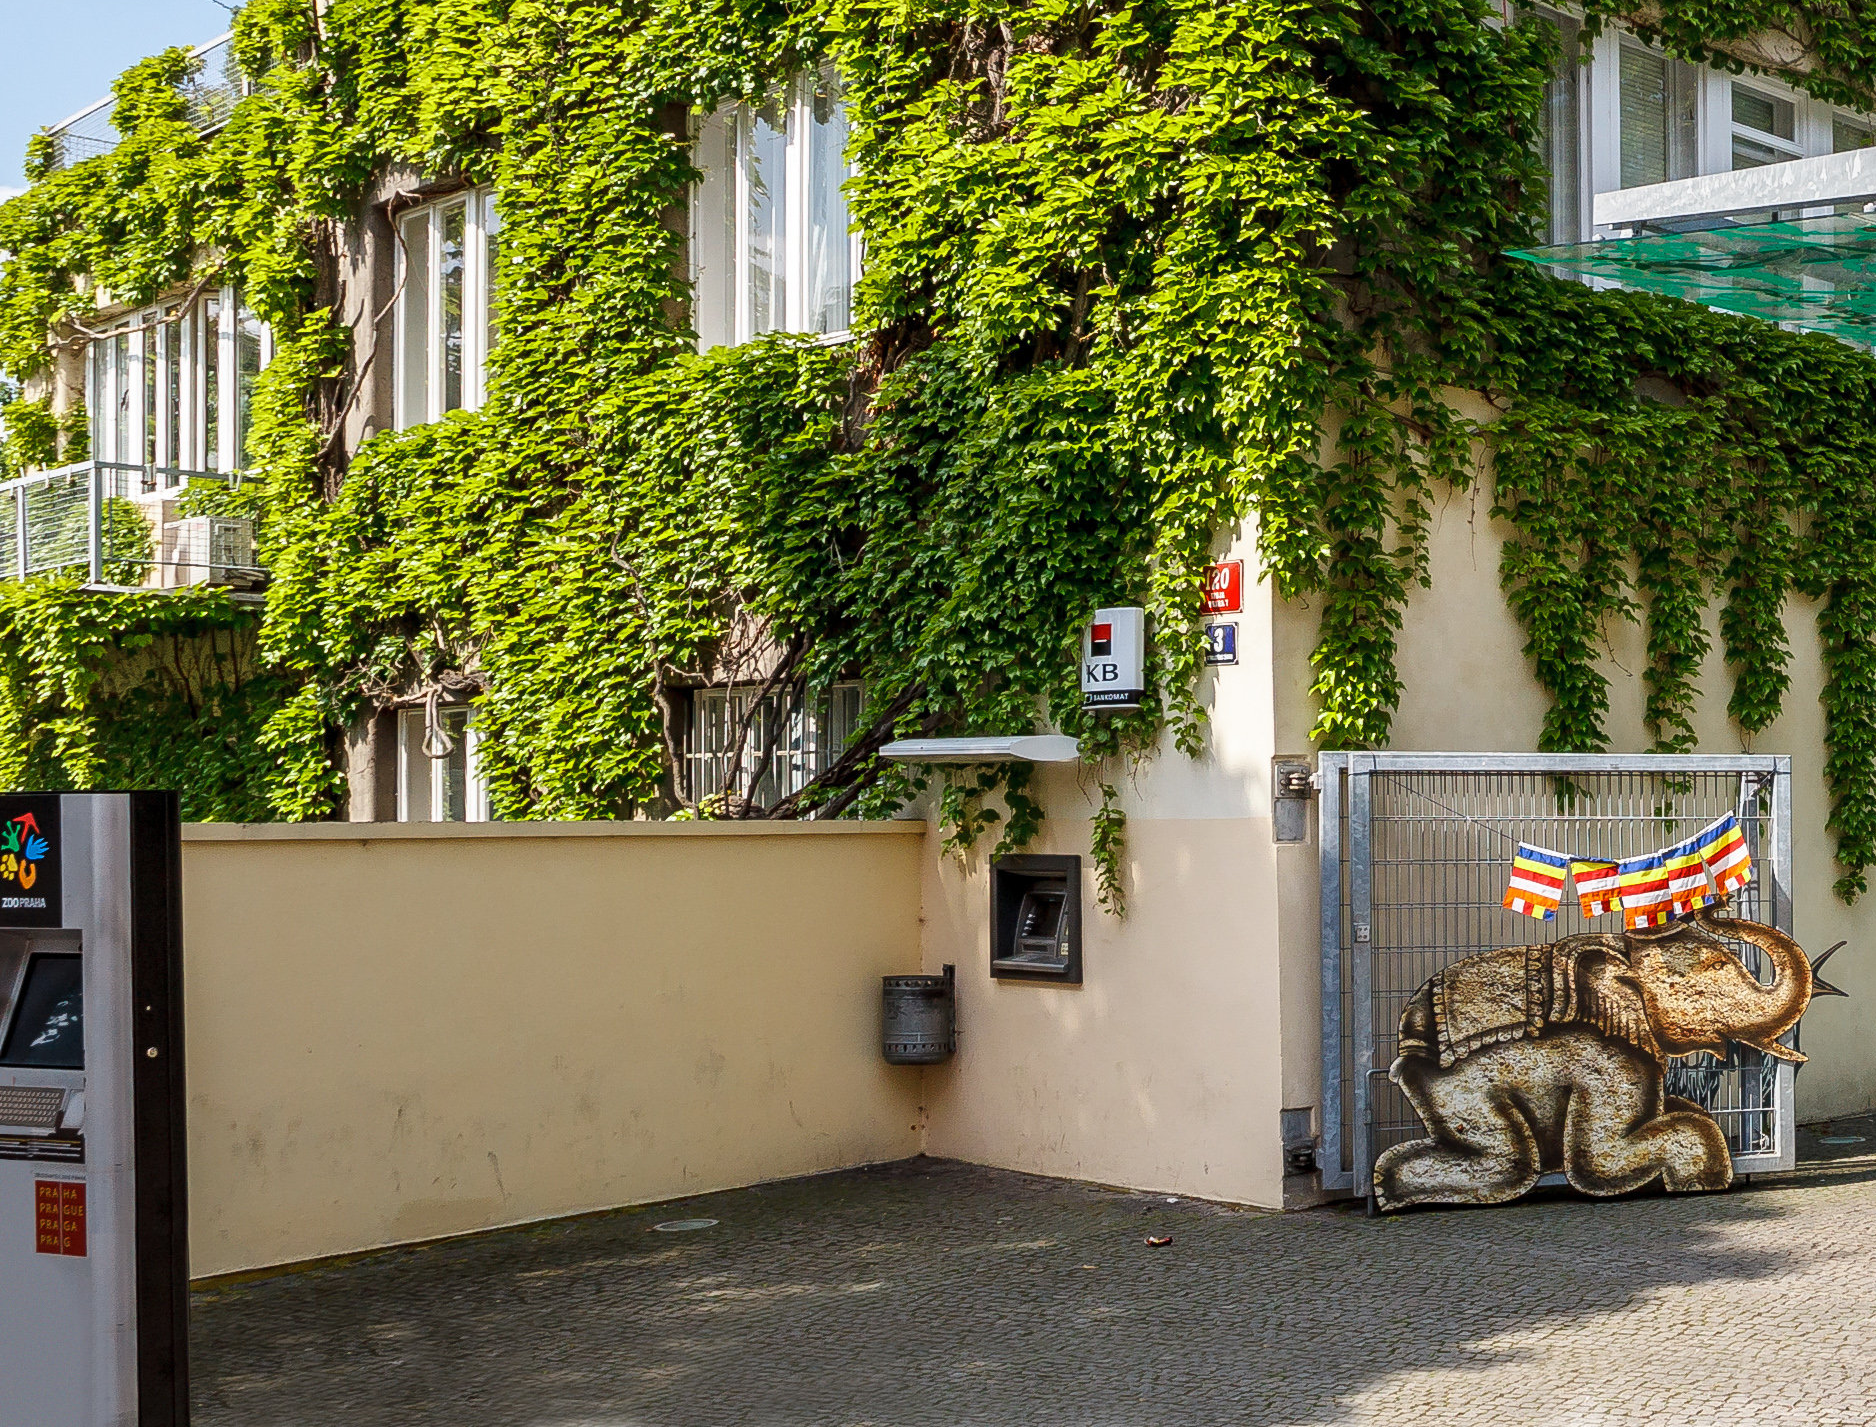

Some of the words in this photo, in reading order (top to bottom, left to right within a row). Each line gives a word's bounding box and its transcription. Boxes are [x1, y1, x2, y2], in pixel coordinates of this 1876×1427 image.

[1205, 567, 1230, 591] 120
[1213, 627, 1224, 653] 3
[1086, 663, 1119, 683] KB
[1093, 692, 1129, 701] BANKOMAT
[1, 897, 20, 909] ZOO
[20, 897, 47, 909] PRAHA
